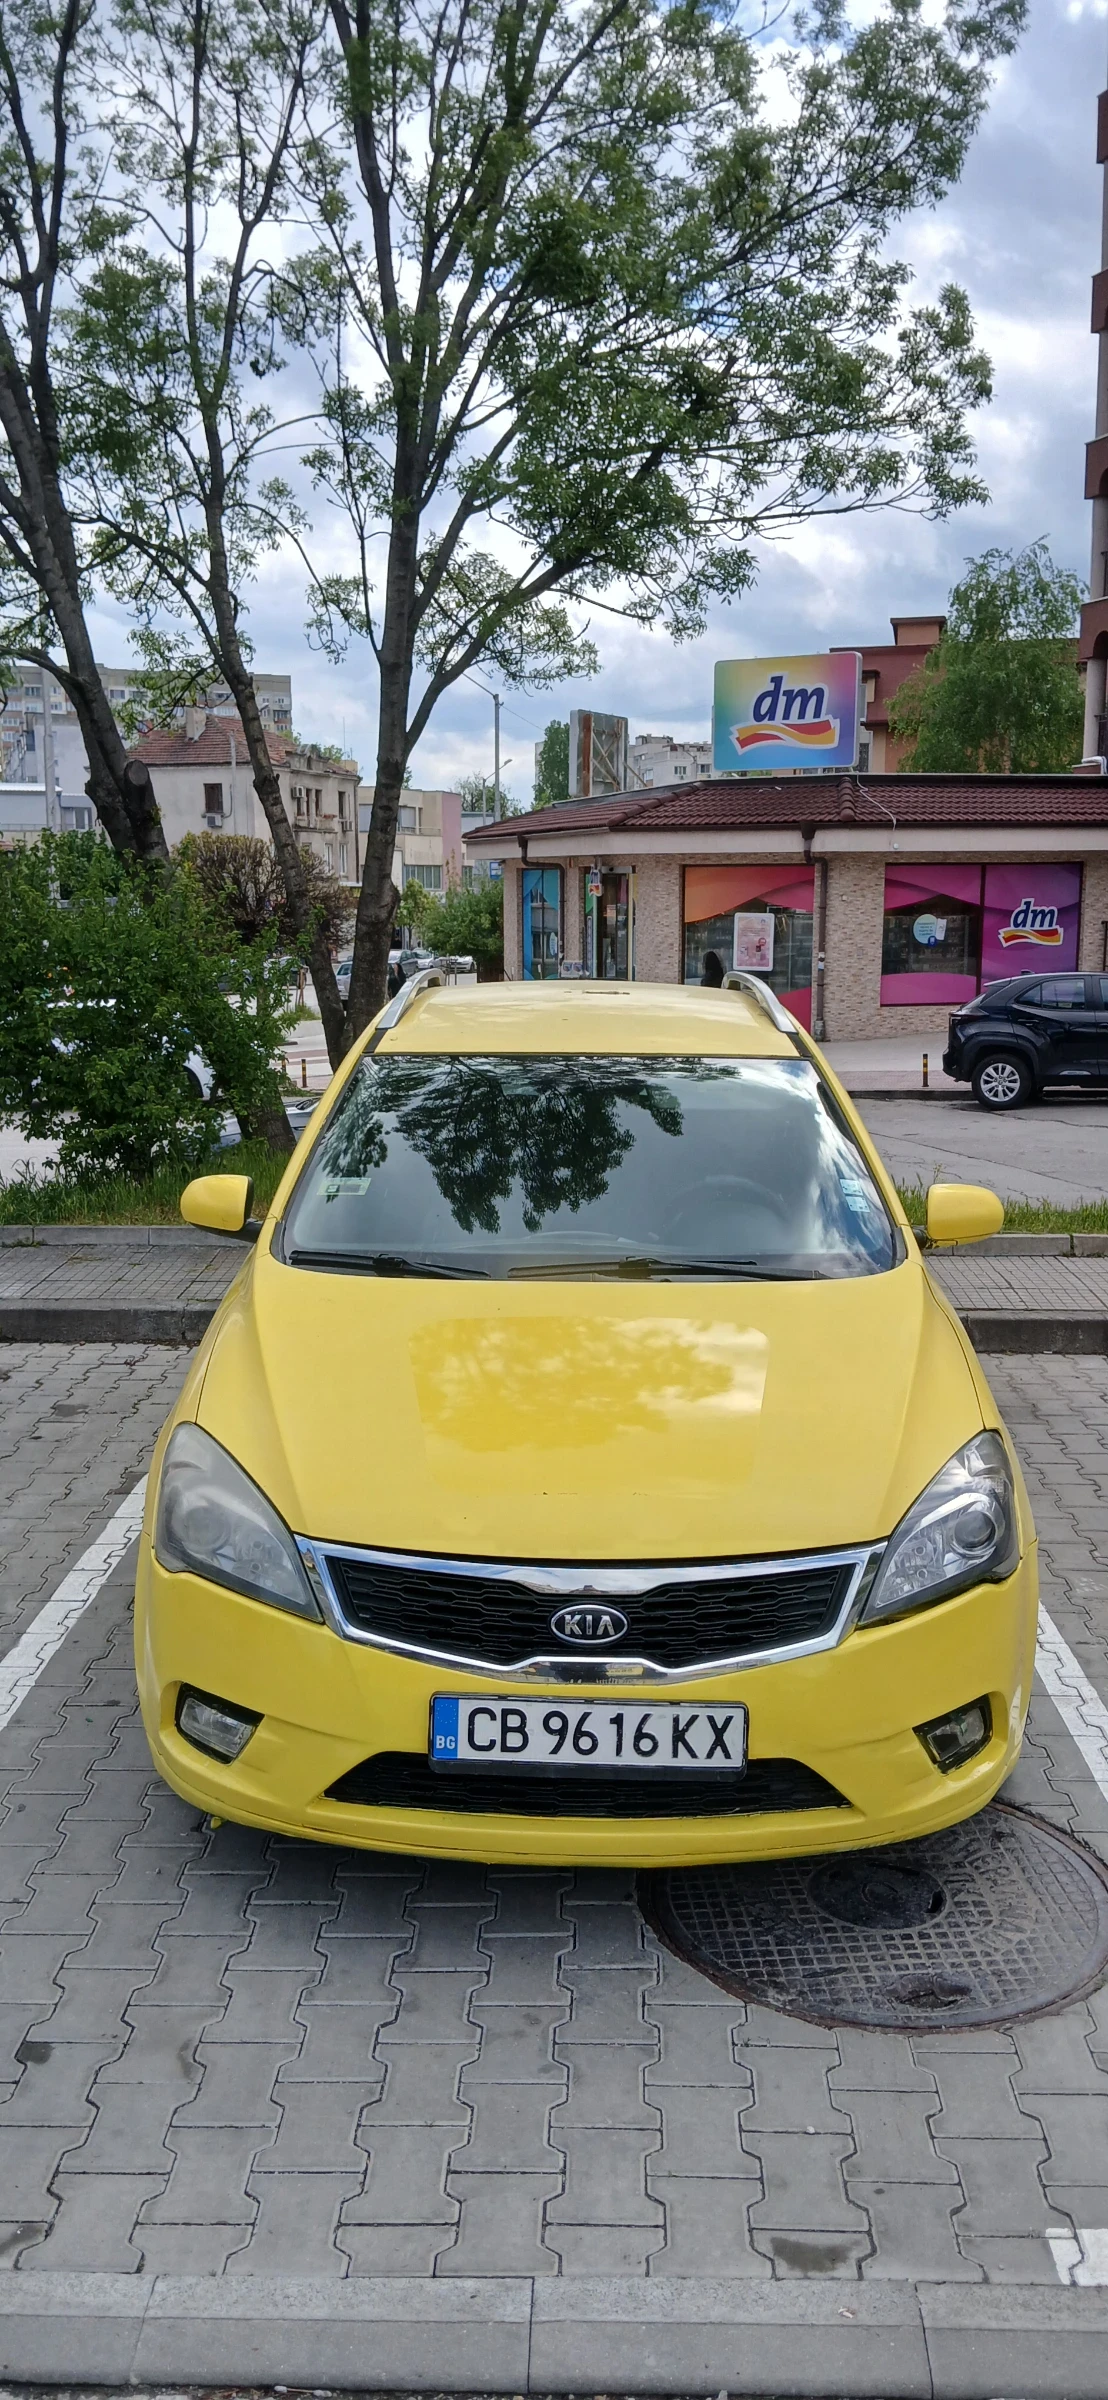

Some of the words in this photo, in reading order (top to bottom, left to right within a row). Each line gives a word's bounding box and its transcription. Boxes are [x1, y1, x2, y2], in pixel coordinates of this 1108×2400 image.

[752, 675, 826, 723] dm
[1012, 900, 1056, 929] dm
[563, 1614, 616, 1636] KIA
[435, 1735, 456, 1750] BG
[467, 1706, 530, 1753] CB
[671, 1713, 735, 1760] KX
